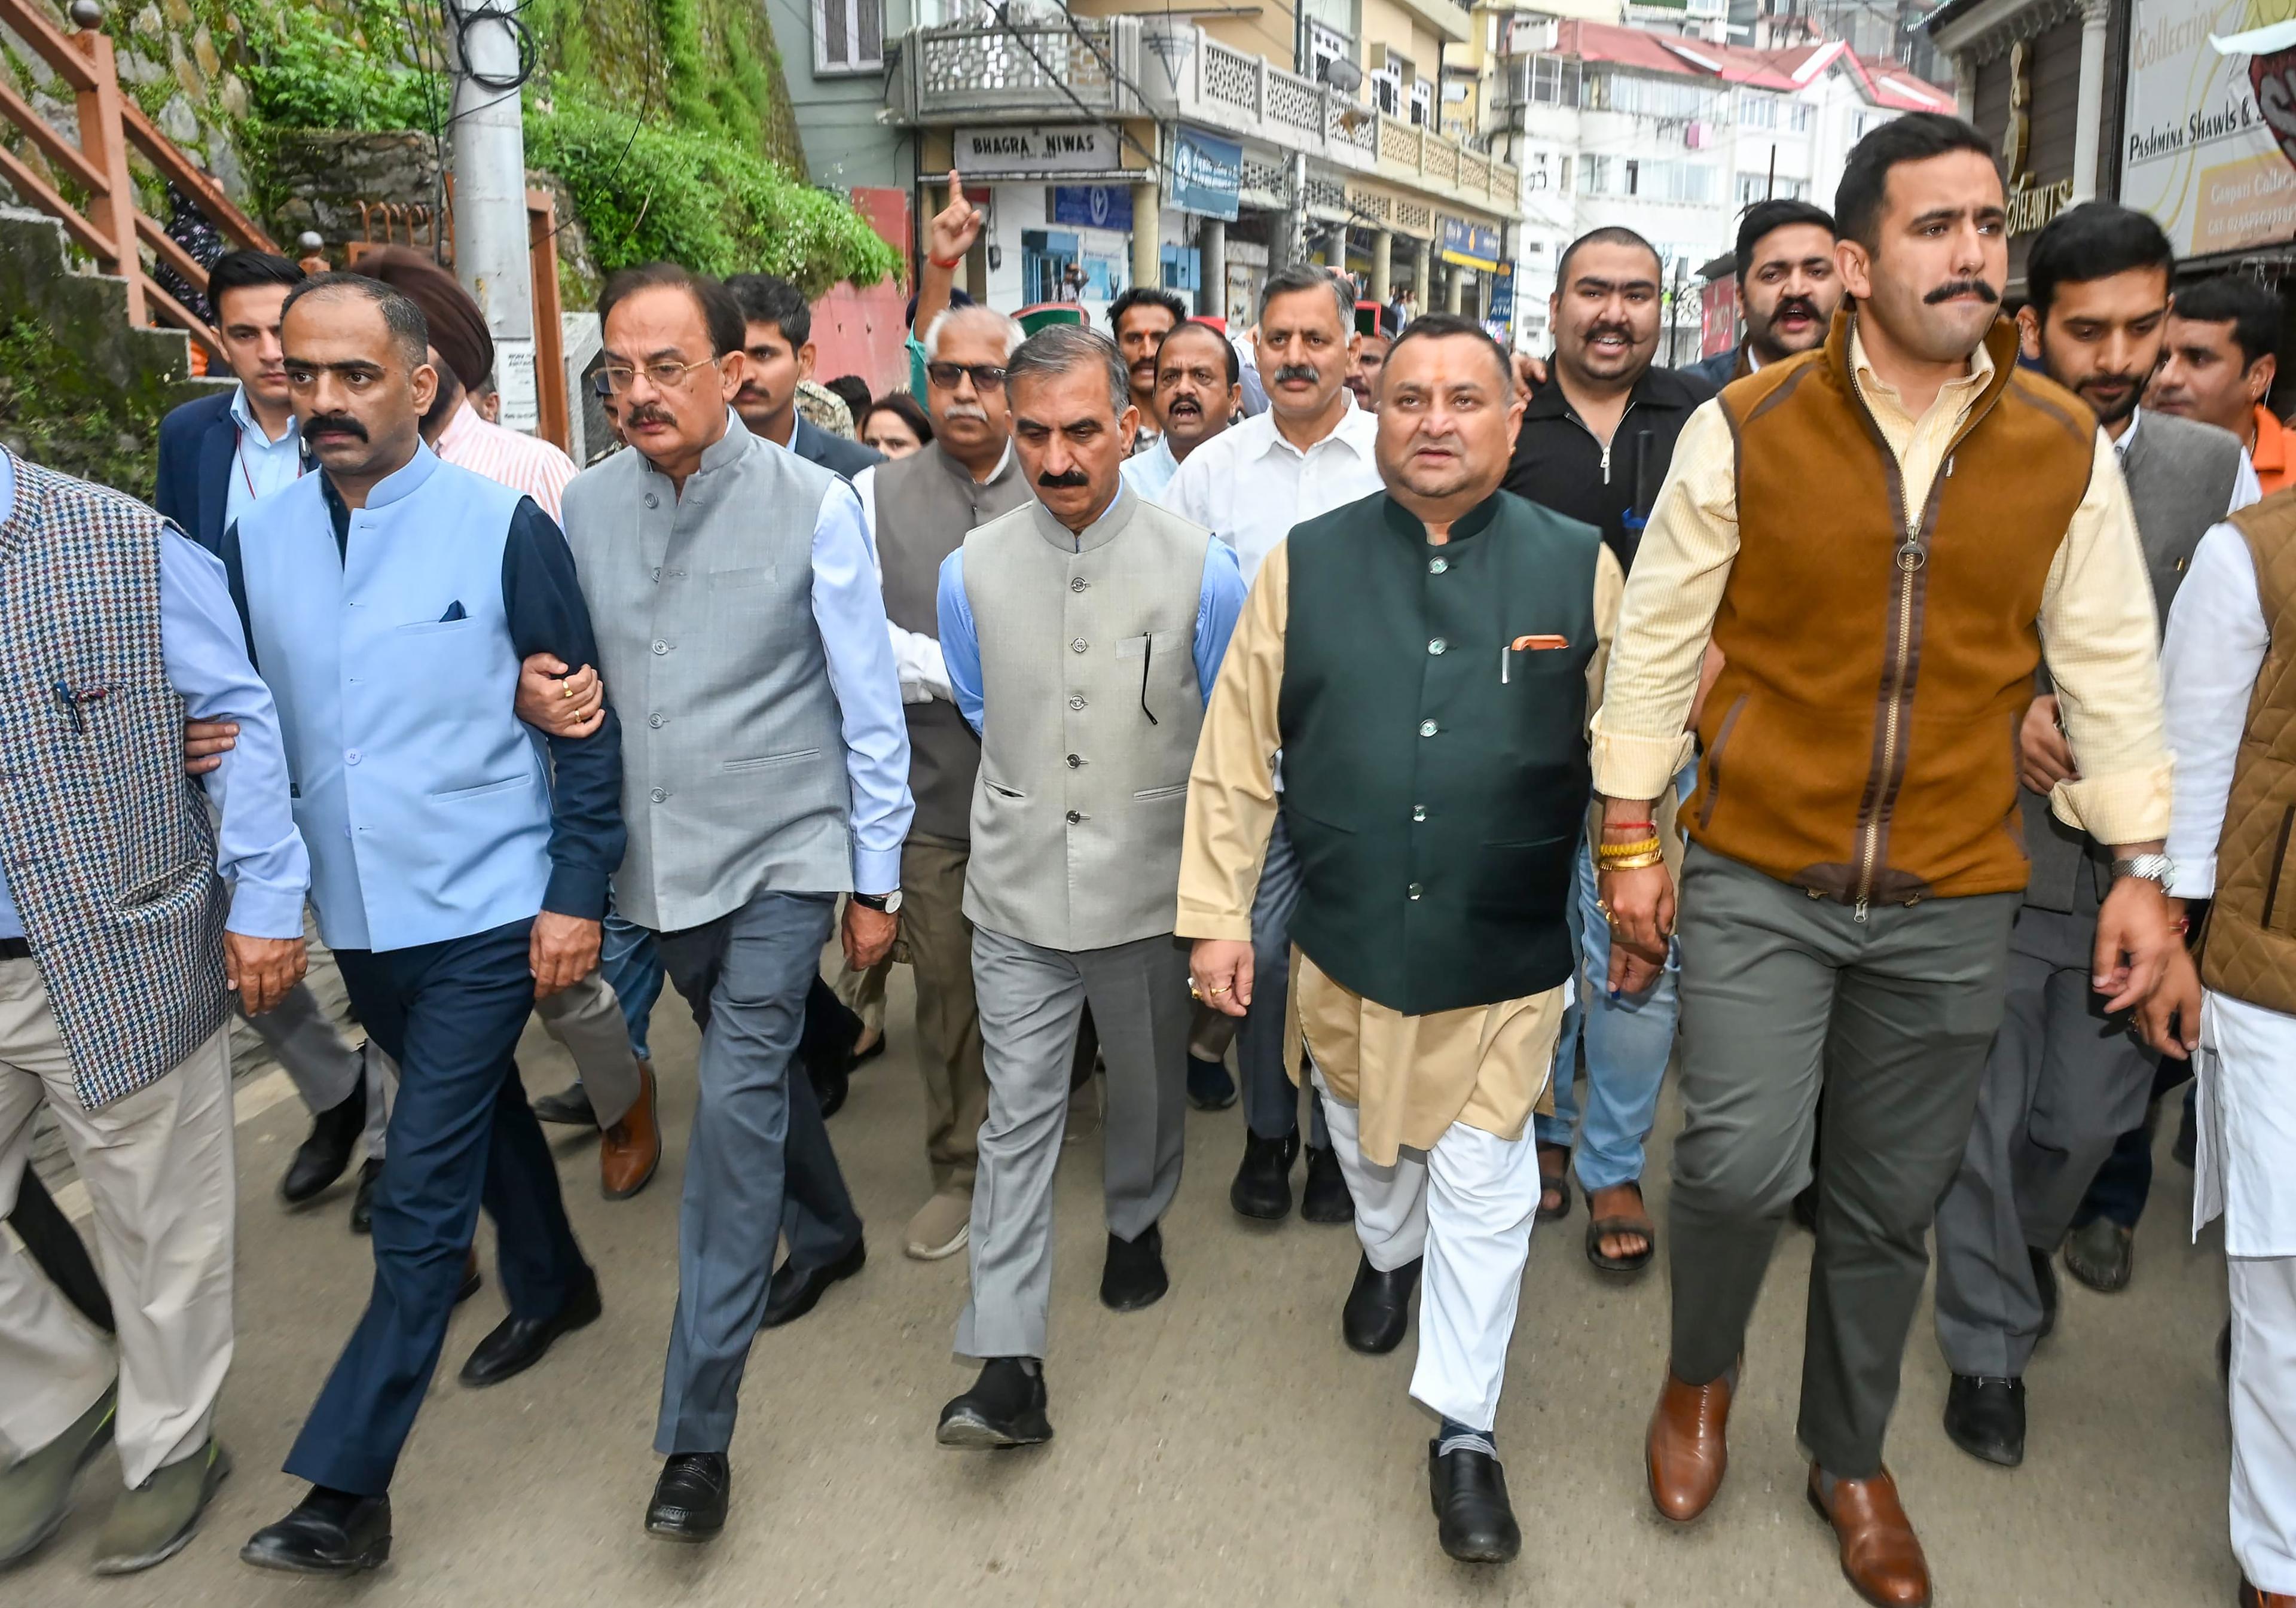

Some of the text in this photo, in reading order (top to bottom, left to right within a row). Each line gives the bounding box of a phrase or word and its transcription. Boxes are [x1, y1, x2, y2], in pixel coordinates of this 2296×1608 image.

[2189, 100, 2237, 143] Shawls
[2242, 95, 2251, 127] &
[973, 134, 1094, 155] BHAGRA NIWAS
[1491, 305, 1510, 317] ATM
